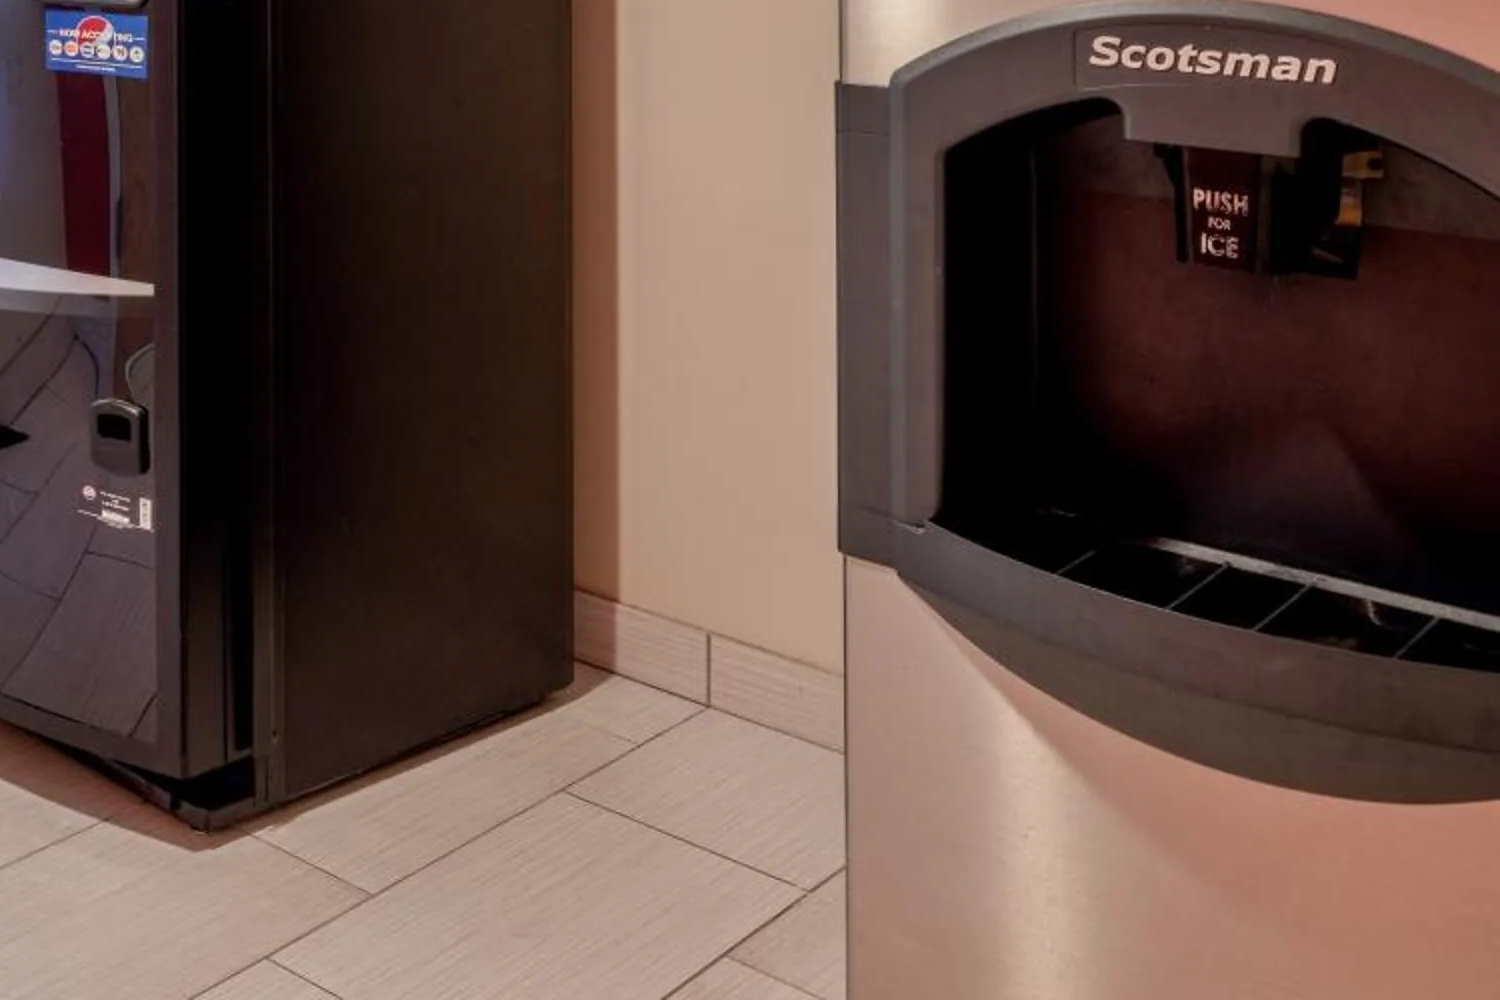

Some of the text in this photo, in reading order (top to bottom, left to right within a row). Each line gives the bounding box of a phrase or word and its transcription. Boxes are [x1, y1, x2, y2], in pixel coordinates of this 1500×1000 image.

[1088, 35, 1338, 84] Scotsman
[1193, 187, 1249, 217] PUSH
[1207, 216, 1231, 231] FOR
[1200, 232, 1239, 260] ICE
